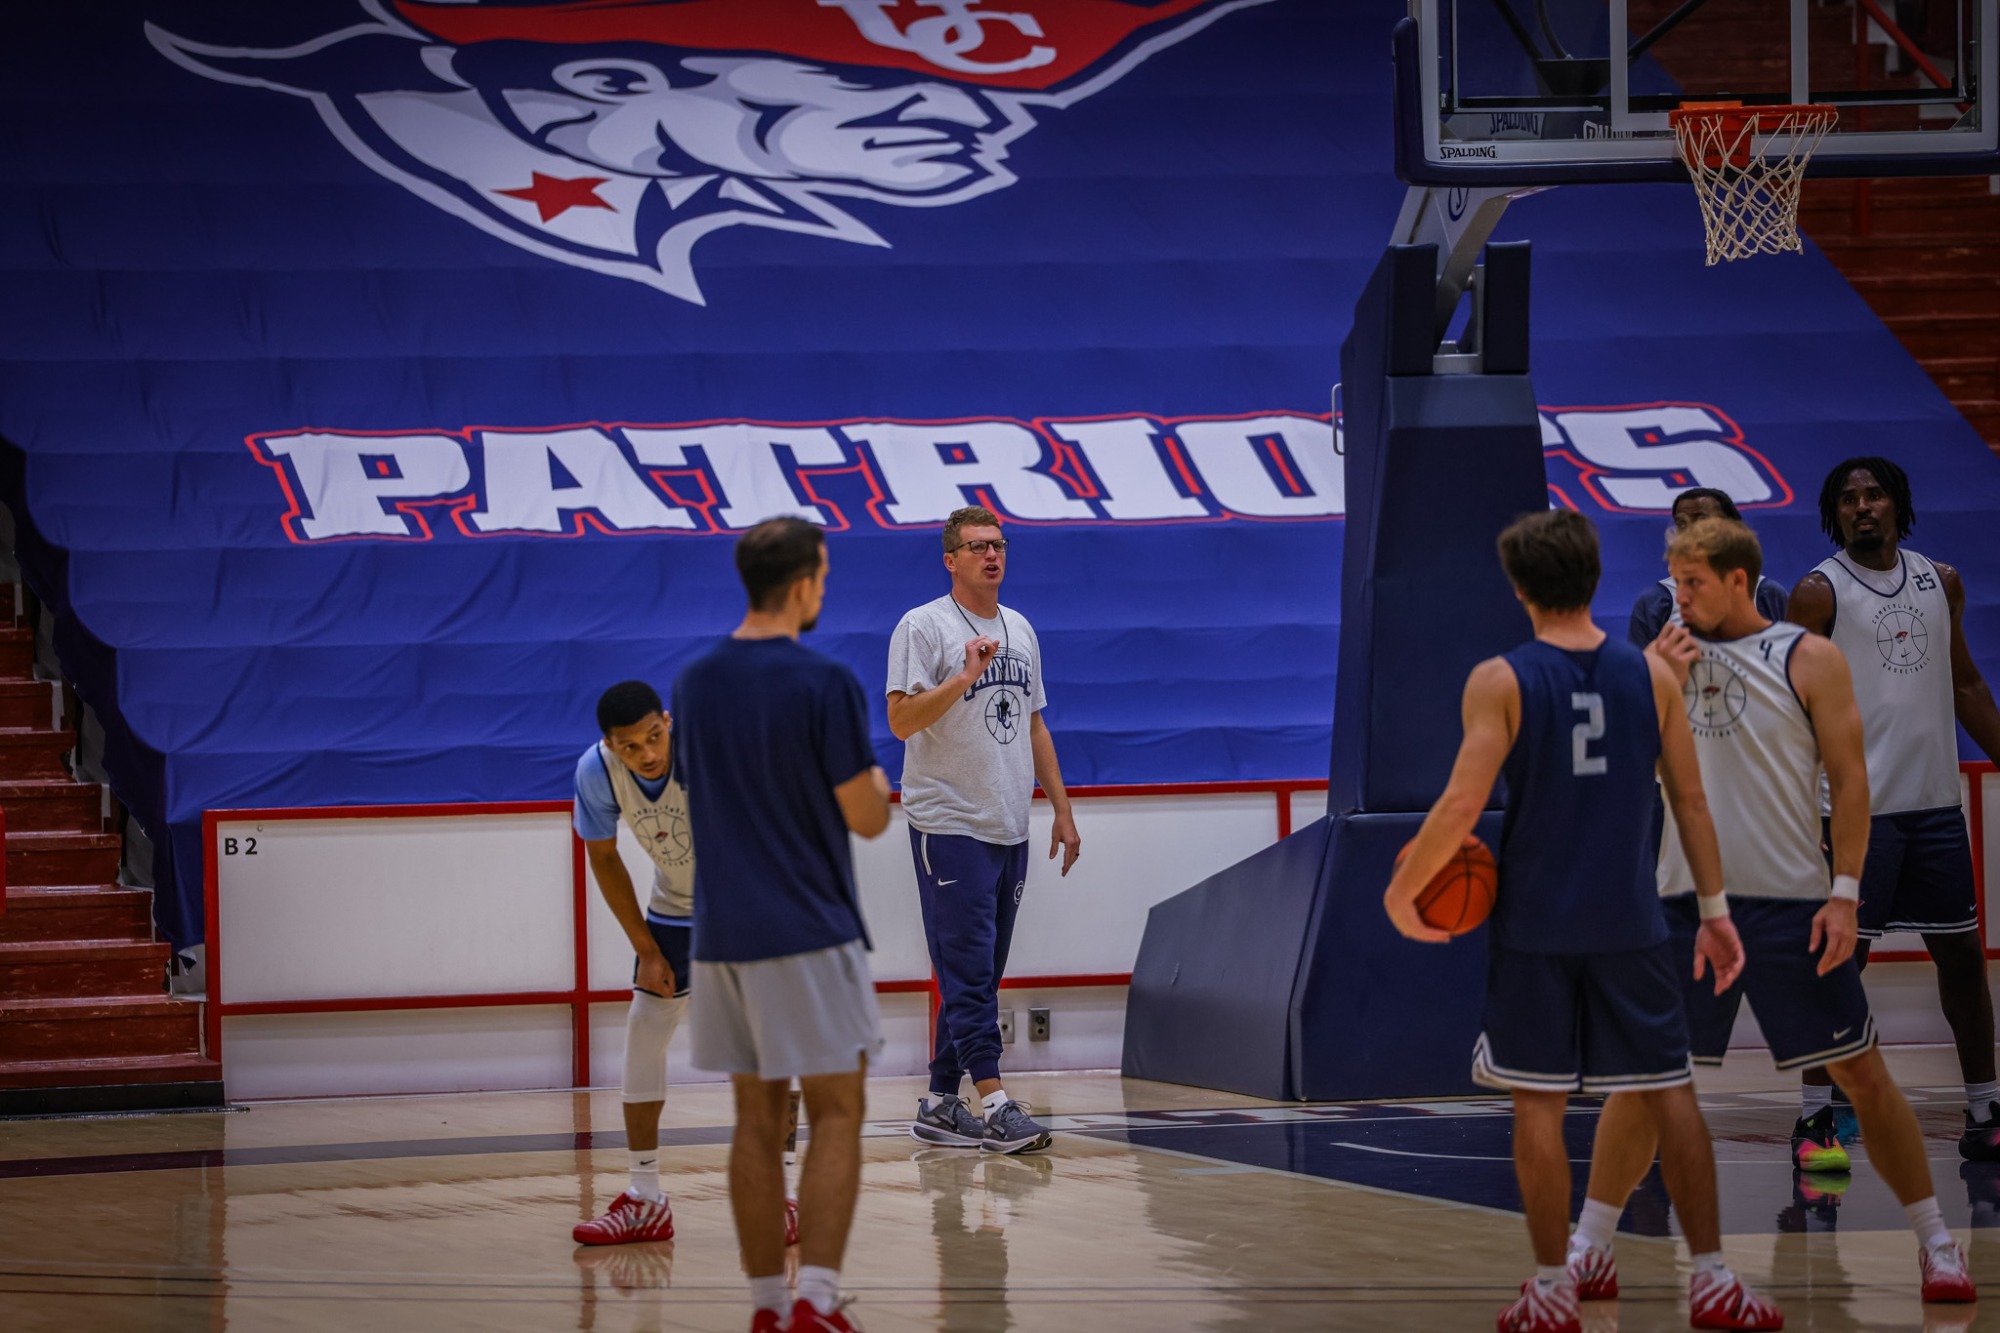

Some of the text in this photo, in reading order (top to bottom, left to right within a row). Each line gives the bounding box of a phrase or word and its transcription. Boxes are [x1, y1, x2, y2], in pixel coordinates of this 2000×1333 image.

[1439, 145, 1498, 159] SPALDING
[245, 401, 1794, 545] PATRIOS
[1912, 571, 1937, 592] 25
[1759, 639, 1773, 662] 4
[1571, 691, 1608, 776] 2
[224, 837, 258, 856] B 2
